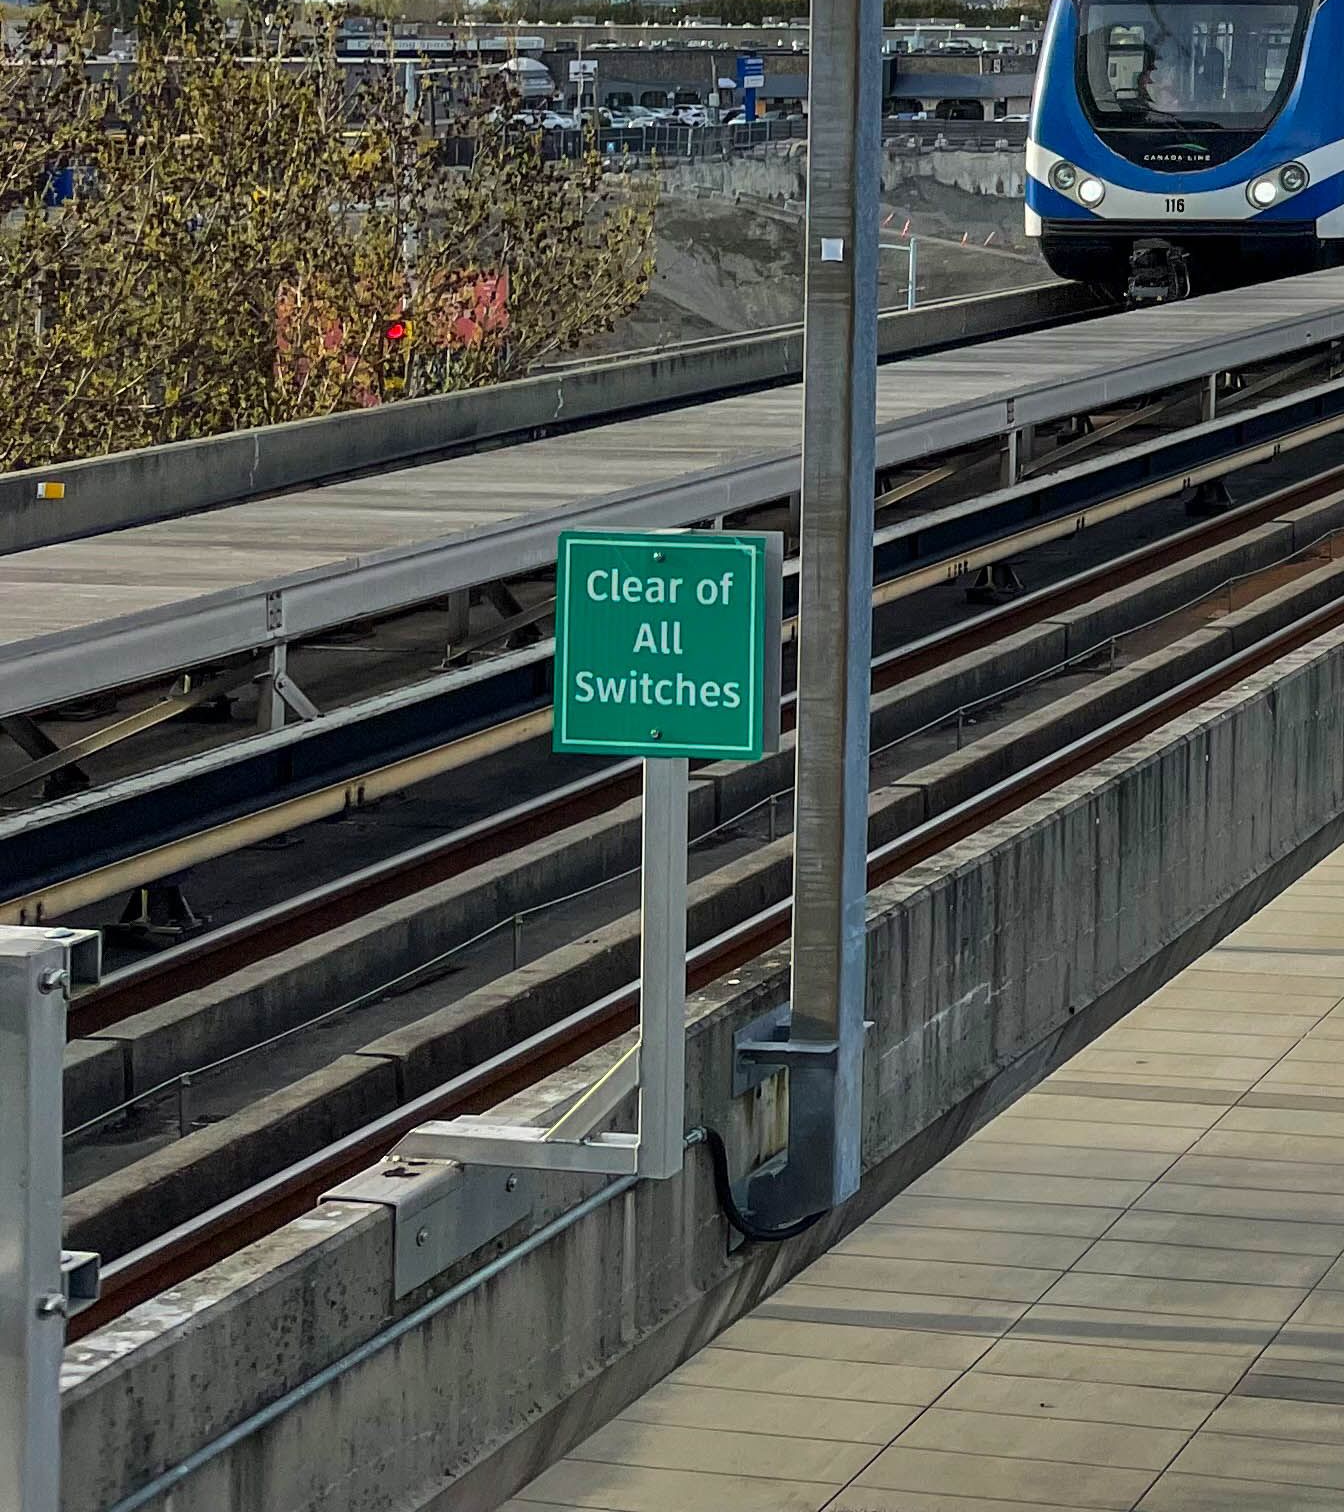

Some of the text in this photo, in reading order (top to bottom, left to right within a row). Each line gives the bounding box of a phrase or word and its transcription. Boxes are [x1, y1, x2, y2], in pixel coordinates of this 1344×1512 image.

[1164, 198, 1185, 213] 116
[587, 569, 734, 605] Clear of
[632, 621, 683, 655] All
[575, 670, 741, 708] Switches
